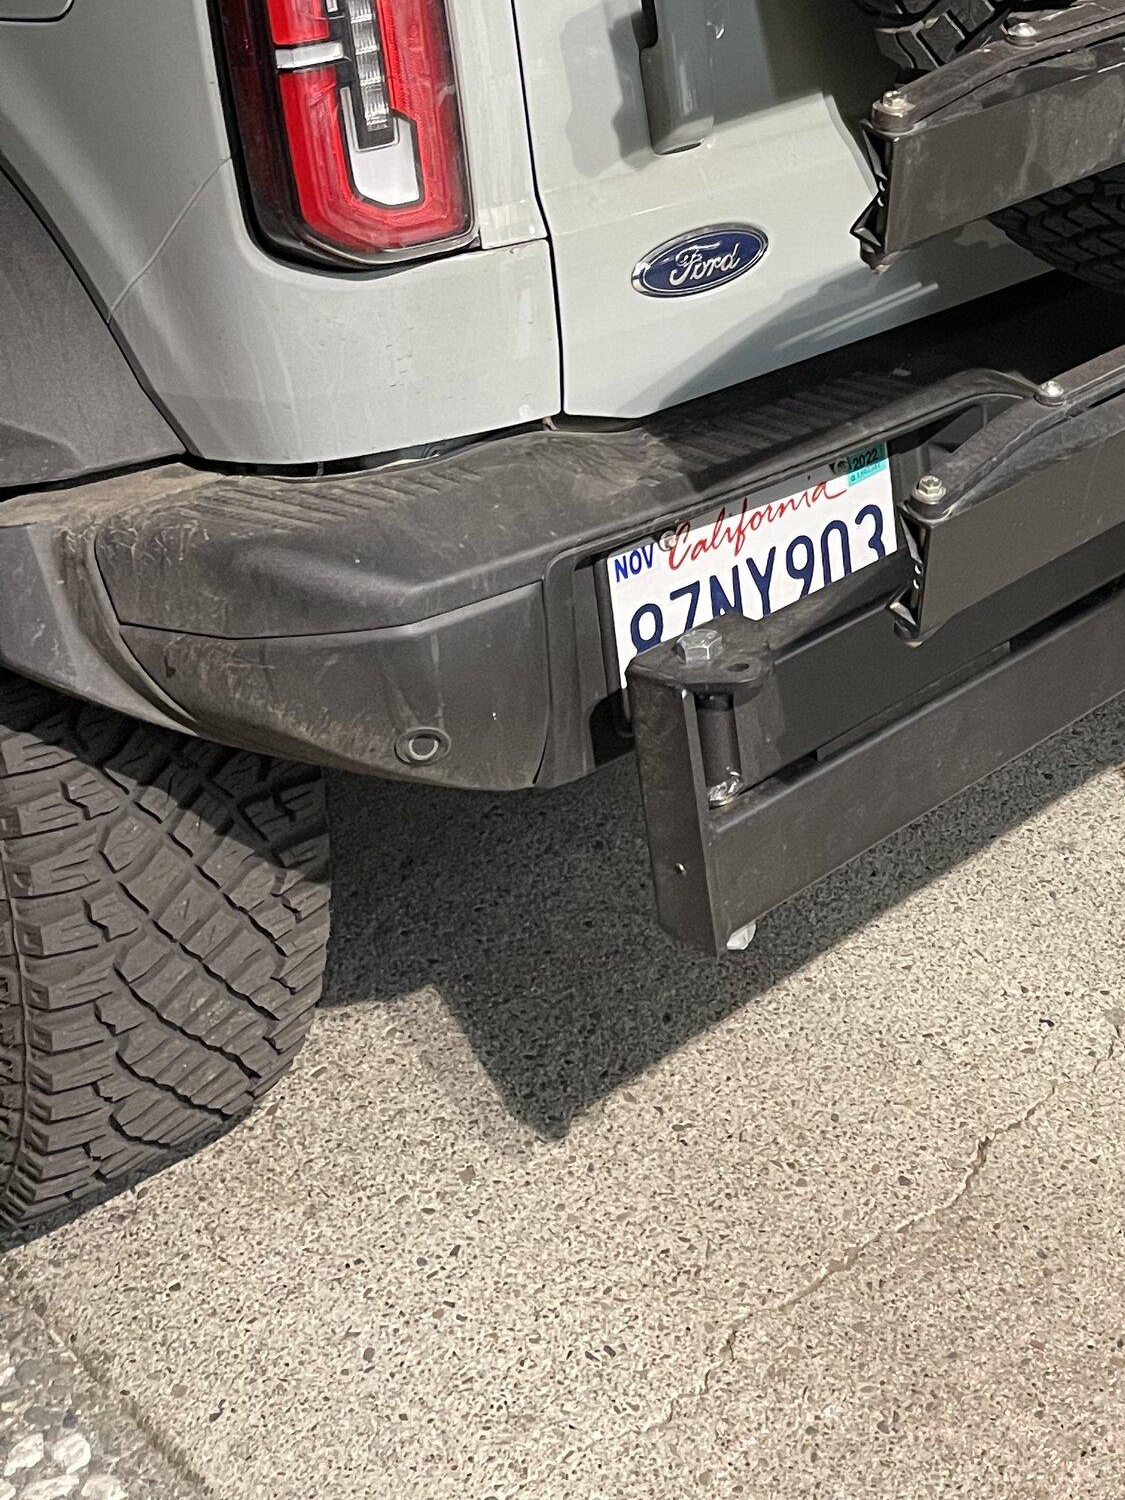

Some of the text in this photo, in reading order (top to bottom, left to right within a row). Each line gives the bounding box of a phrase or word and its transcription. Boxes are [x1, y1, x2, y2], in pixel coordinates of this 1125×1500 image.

[669, 241, 741, 286] Ford
[668, 480, 848, 571] California
[614, 543, 655, 582] NOV
